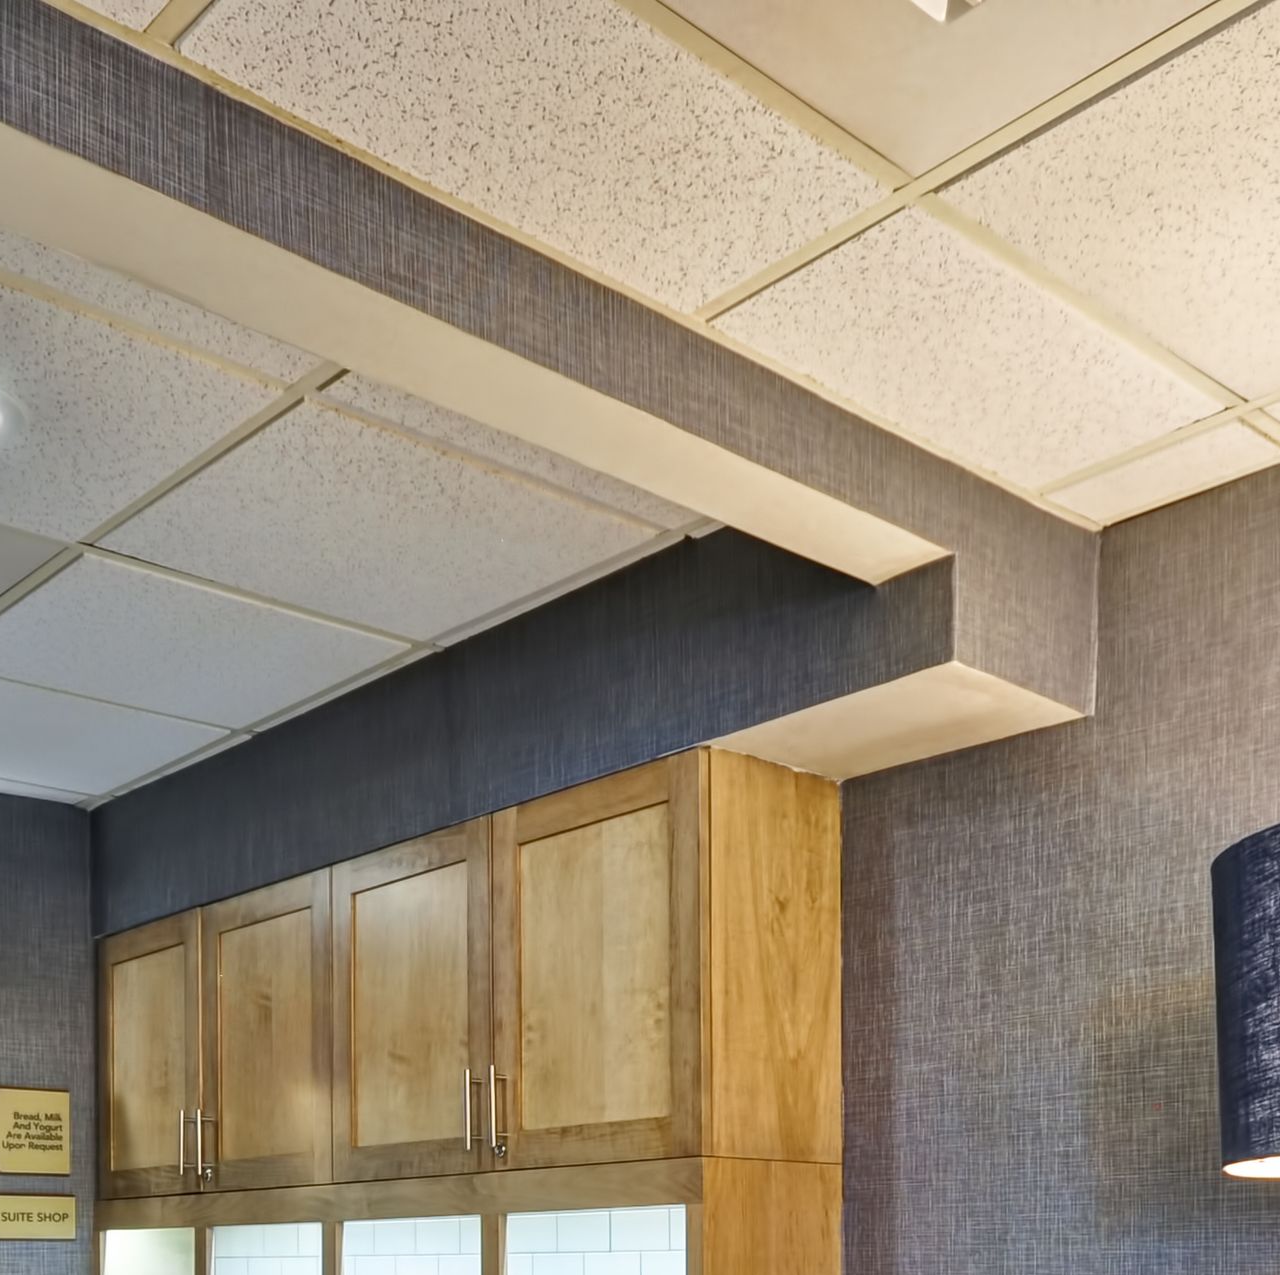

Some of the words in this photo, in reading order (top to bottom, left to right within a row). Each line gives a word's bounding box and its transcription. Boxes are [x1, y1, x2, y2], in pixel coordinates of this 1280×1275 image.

[13, 1112, 42, 1122] Bread,
[45, 1113, 62, 1121] Milk
[13, 1122, 31, 1131] And
[33, 1122, 63, 1132] Yogurt
[6, 1131, 22, 1140] Are
[24, 1132, 63, 1142] Available
[2, 1140, 26, 1151] Upon
[28, 1142, 63, 1152] Request
[1, 1211, 33, 1222] SUITE
[37, 1212, 69, 1223] SHOP
